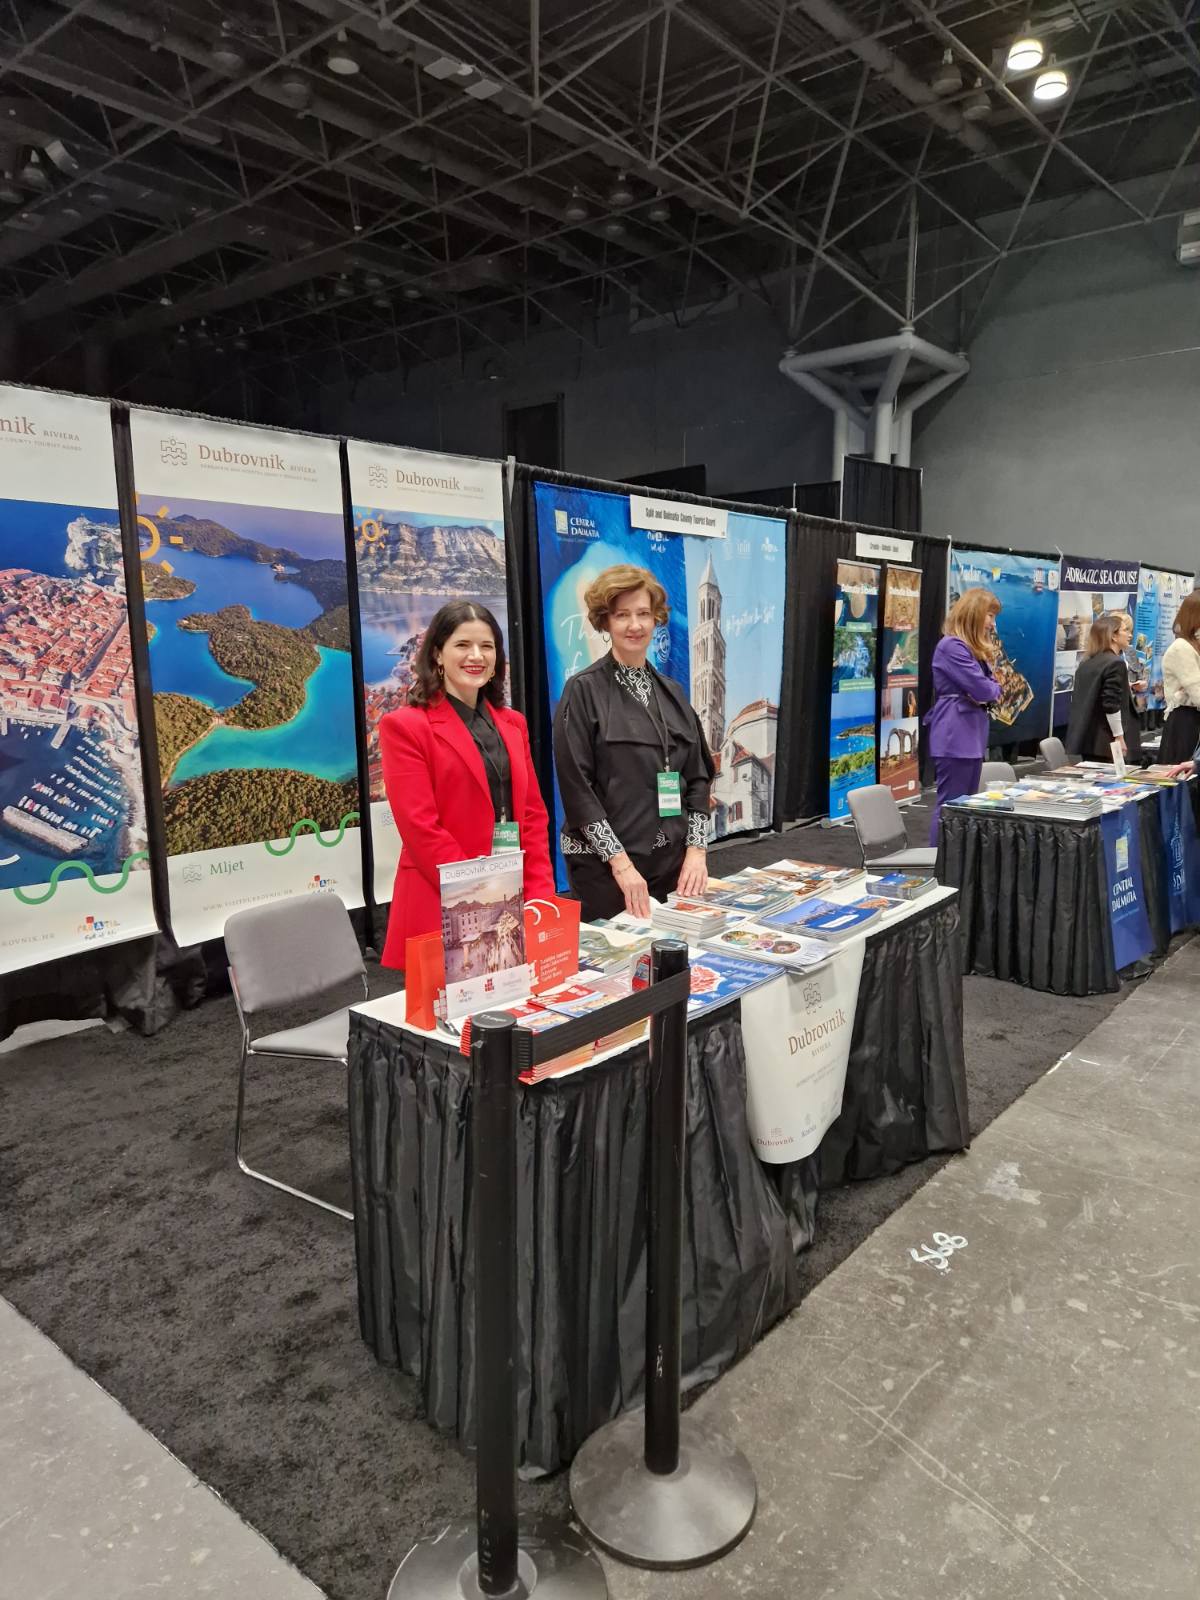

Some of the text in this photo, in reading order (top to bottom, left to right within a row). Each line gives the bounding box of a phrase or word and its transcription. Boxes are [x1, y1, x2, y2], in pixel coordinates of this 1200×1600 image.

[199, 444, 286, 471] Dubrovnik
[396, 470, 460, 490] Dubrovnik
[1065, 567, 1138, 586] ADRIATIC SEA CRUISE
[210, 860, 244, 876] Mljet
[1113, 877, 1134, 896] CENTRAL
[1112, 890, 1137, 912] DALMATIA
[788, 1008, 846, 1056] Dubrovnik
[757, 1136, 794, 1147] Dubrovnik
